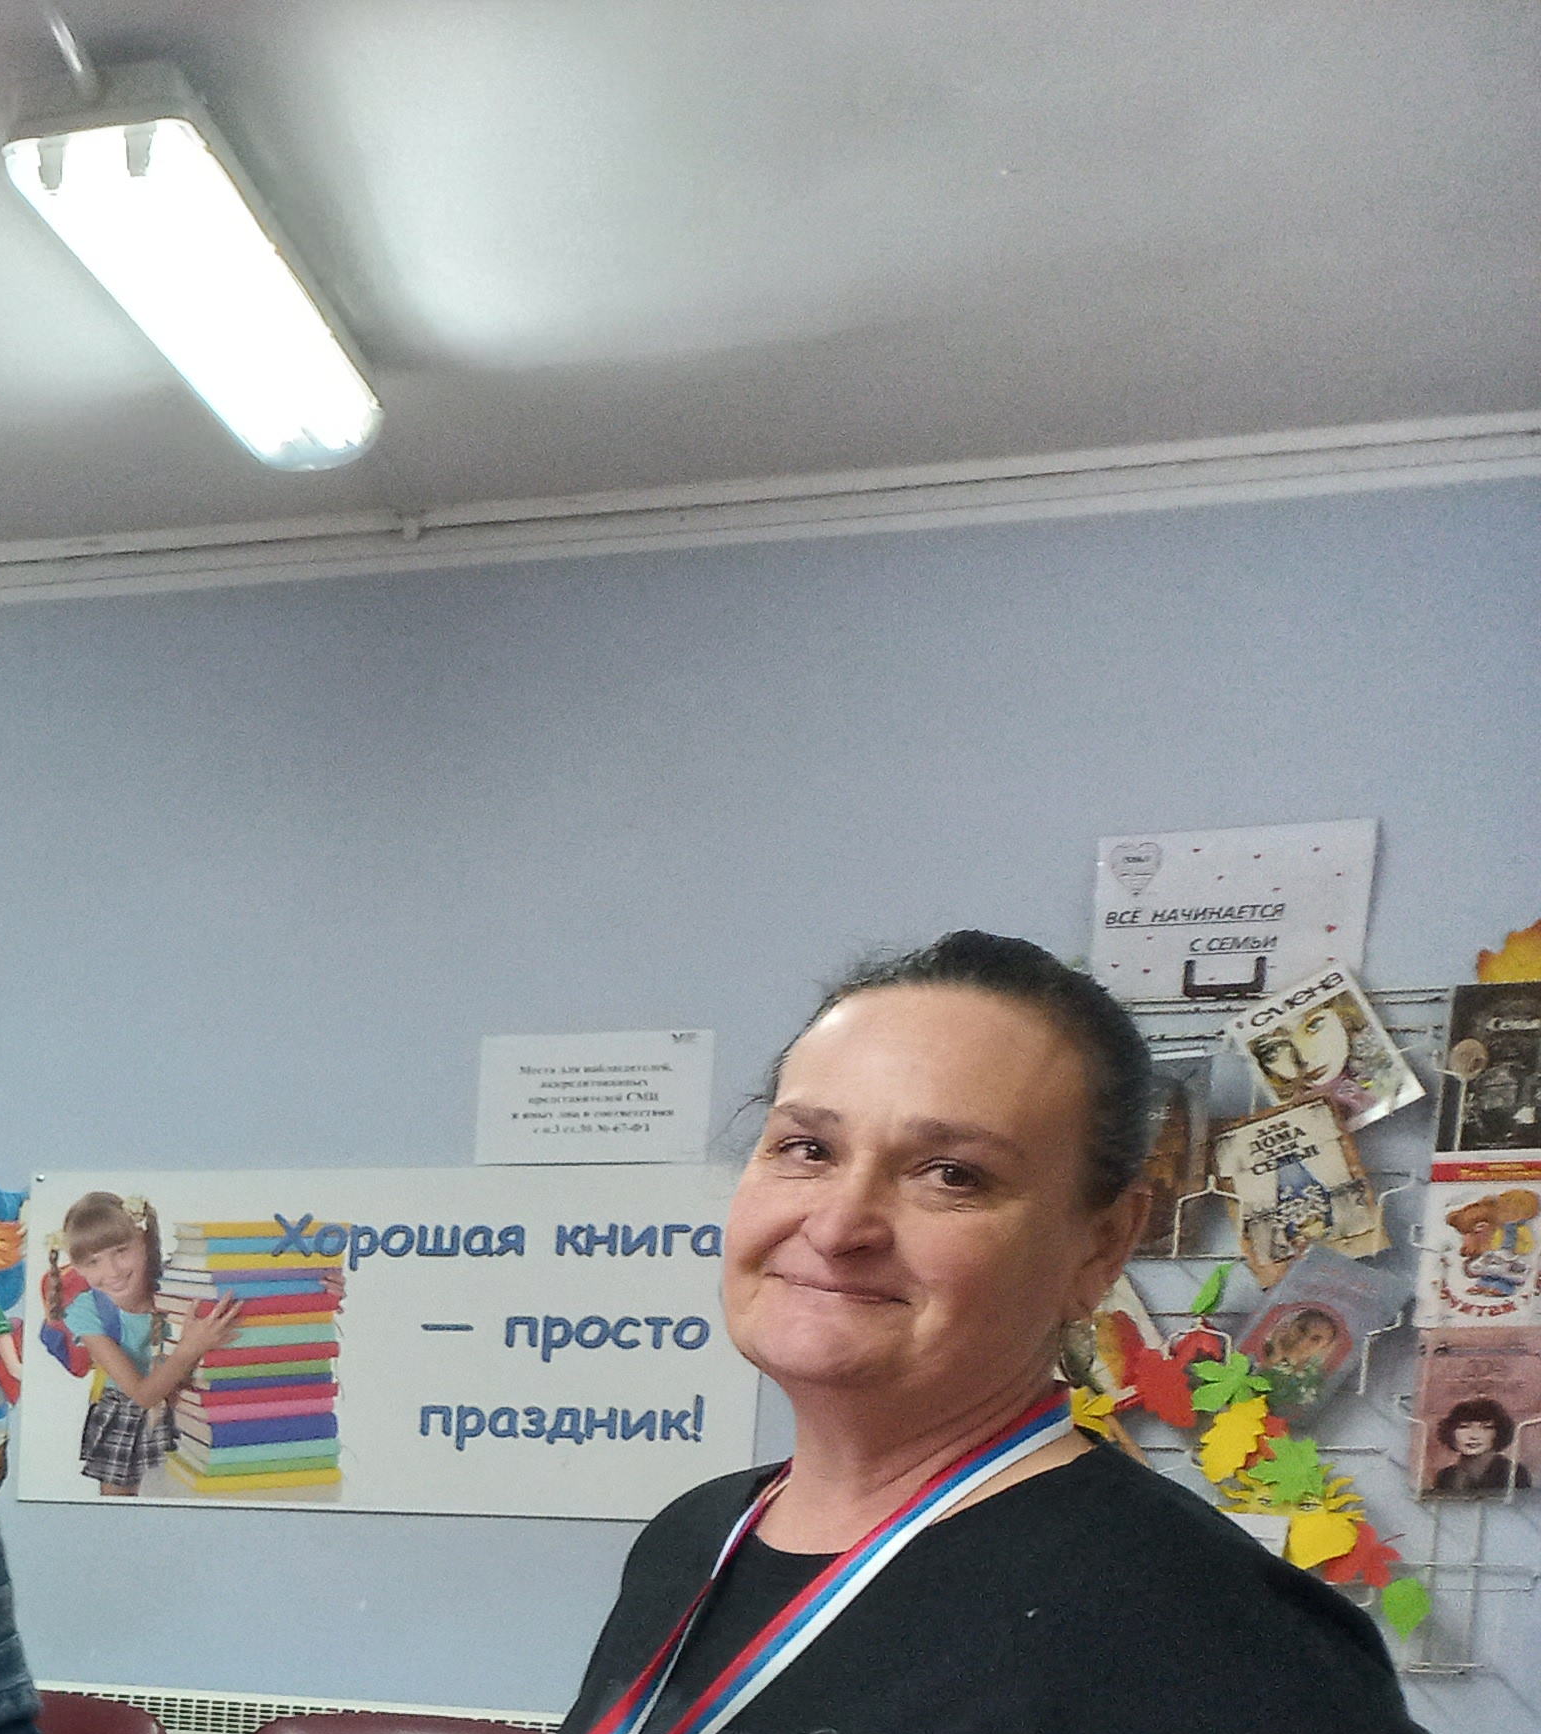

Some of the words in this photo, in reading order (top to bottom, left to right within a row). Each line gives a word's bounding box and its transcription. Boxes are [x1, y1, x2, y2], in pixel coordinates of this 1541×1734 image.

[1151, 903, 1286, 924] НАЧИНАЕТСЯ
[1206, 934, 1278, 952] СЕМЬИ
[271, 1212, 526, 1271] Хорошая
[555, 1223, 722, 1257] книга
[504, 1315, 711, 1363] просто
[420, 1394, 705, 1452] праздник!
